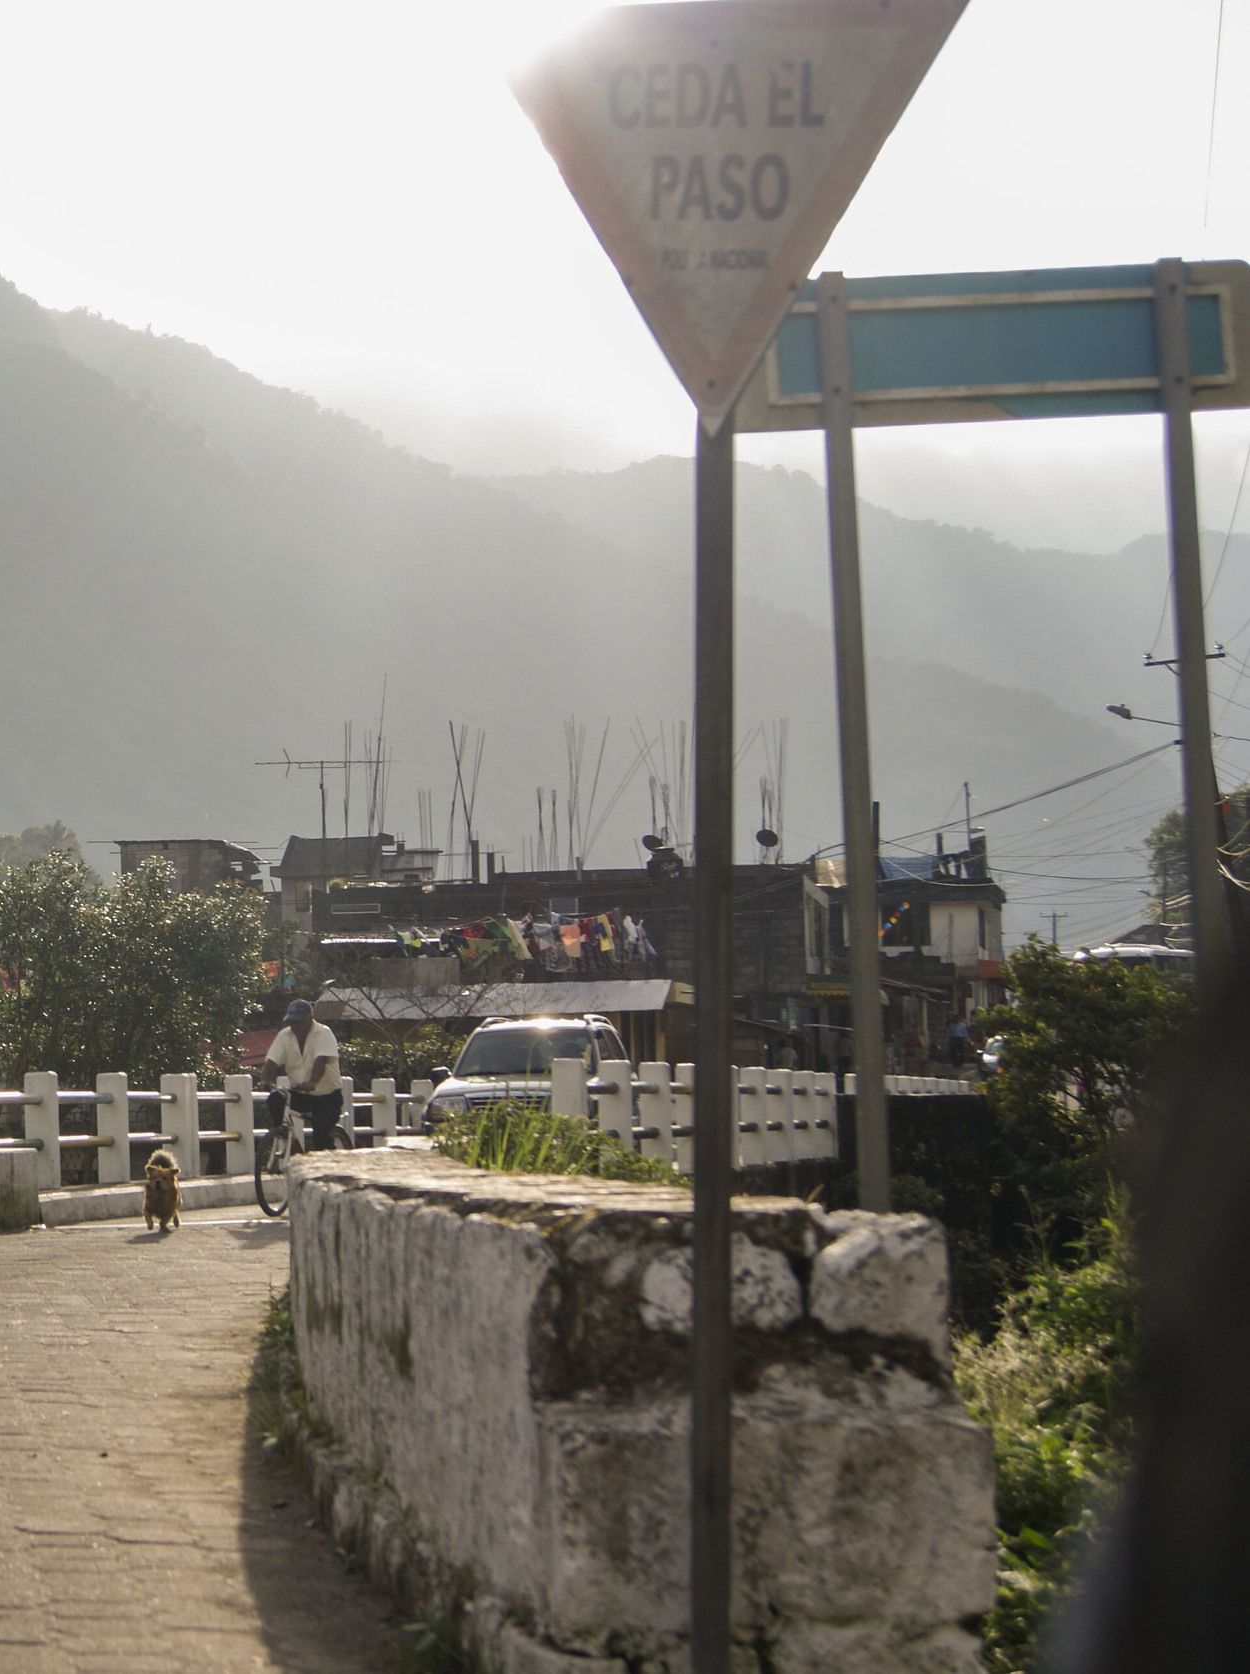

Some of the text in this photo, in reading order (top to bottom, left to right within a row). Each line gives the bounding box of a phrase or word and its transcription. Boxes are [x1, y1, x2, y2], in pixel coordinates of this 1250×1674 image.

[608, 60, 826, 129] CEDA EL
[650, 151, 790, 221] PASO
